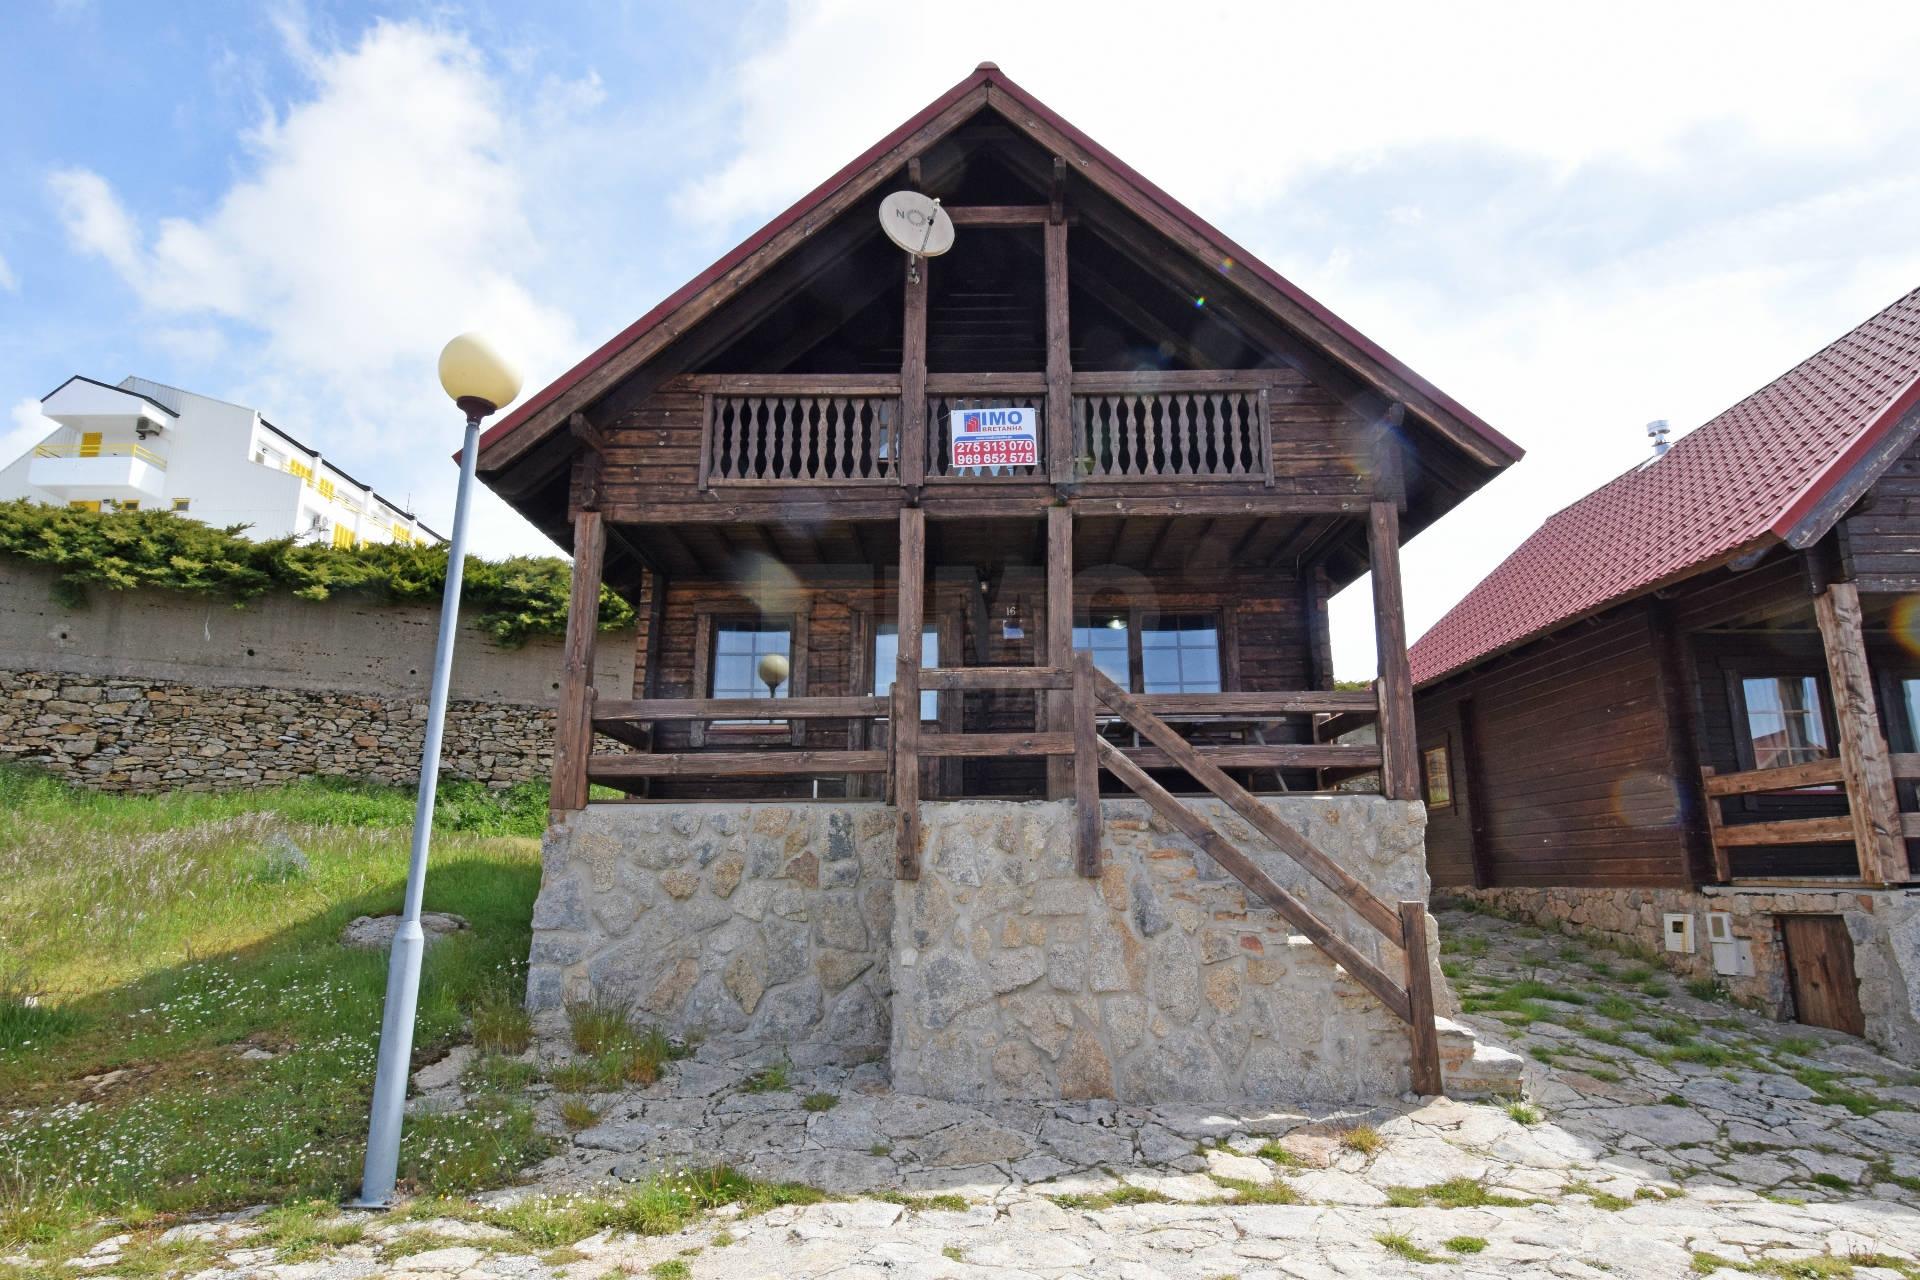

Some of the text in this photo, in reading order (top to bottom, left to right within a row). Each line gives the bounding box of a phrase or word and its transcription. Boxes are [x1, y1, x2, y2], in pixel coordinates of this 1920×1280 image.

[982, 411, 1023, 426] IMO
[957, 440, 1033, 453] 275 313 070
[957, 452, 1033, 465] 969 652 575
[1006, 606, 1016, 616] 16
